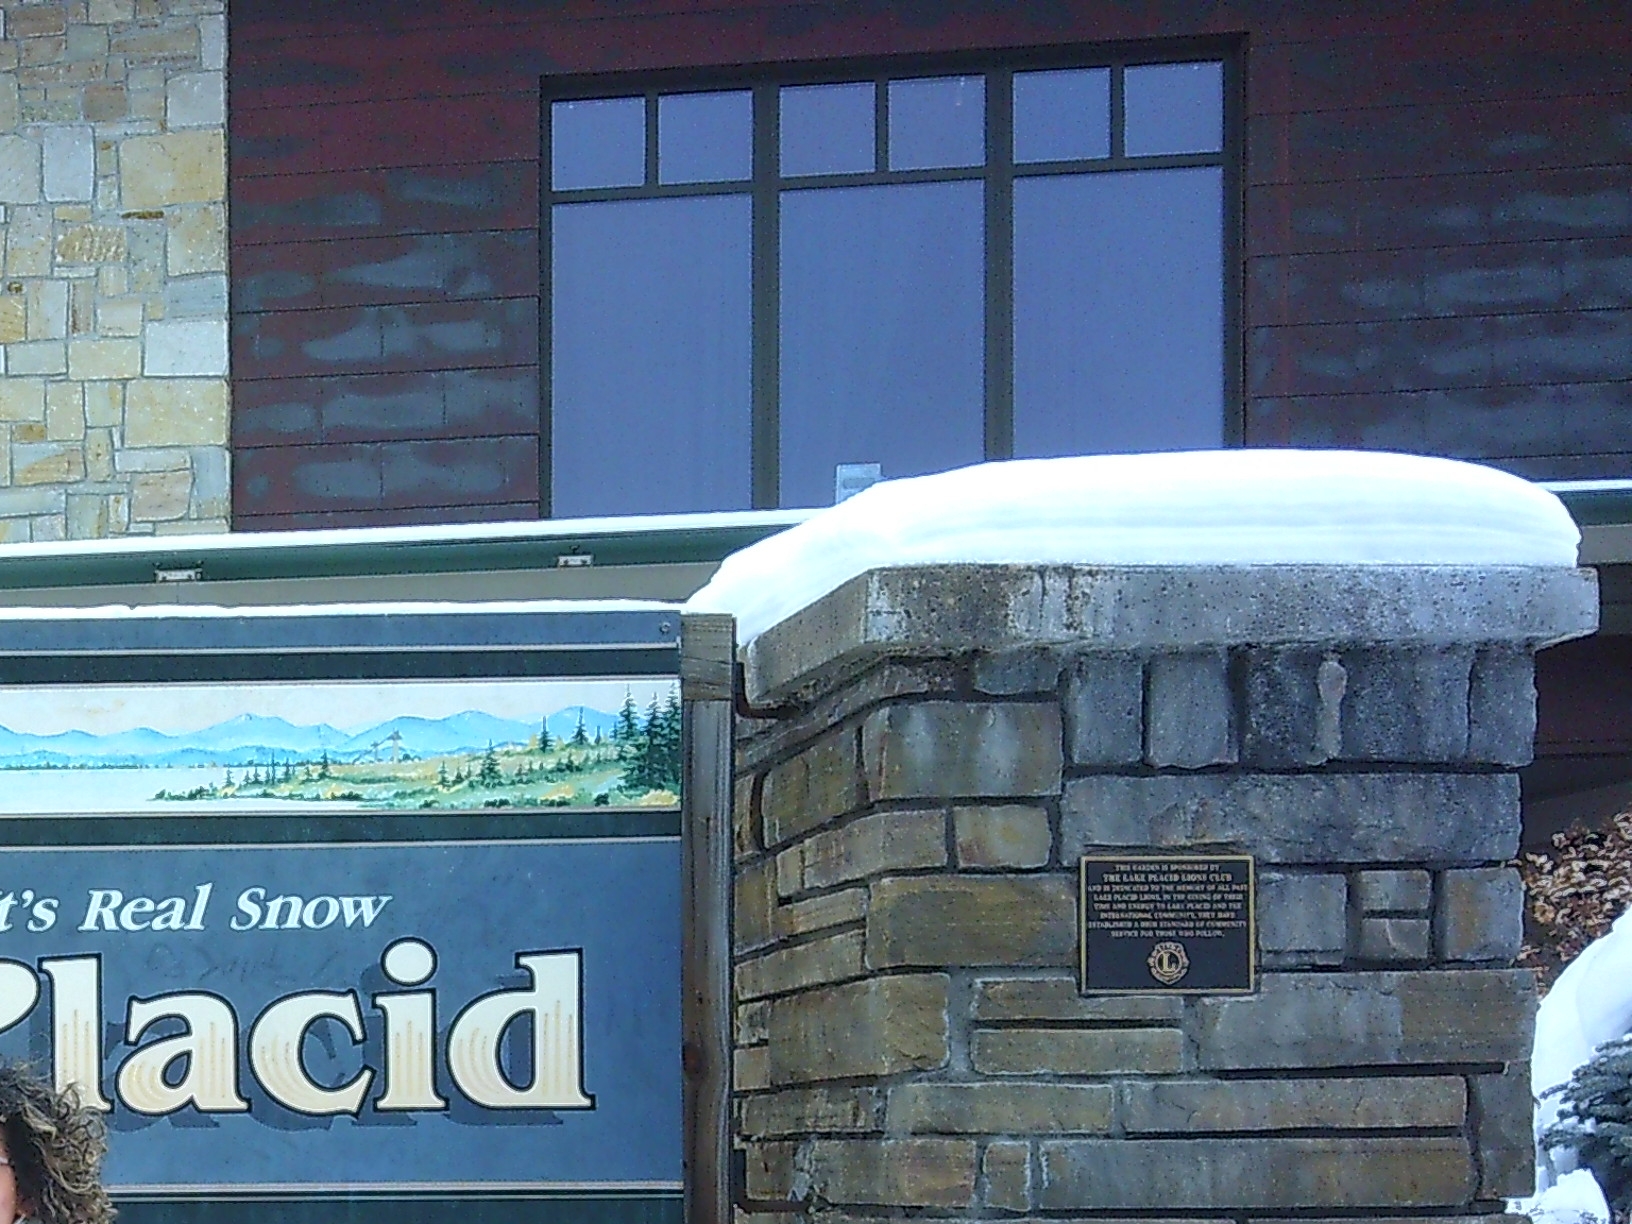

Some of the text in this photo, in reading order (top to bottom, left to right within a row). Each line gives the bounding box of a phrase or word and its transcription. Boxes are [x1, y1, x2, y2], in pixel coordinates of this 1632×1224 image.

[1102, 873, 1232, 882] THE LAKE PLACID LIONS CLUB
[77, 881, 213, 932] Real
[229, 886, 393, 932] Snow
